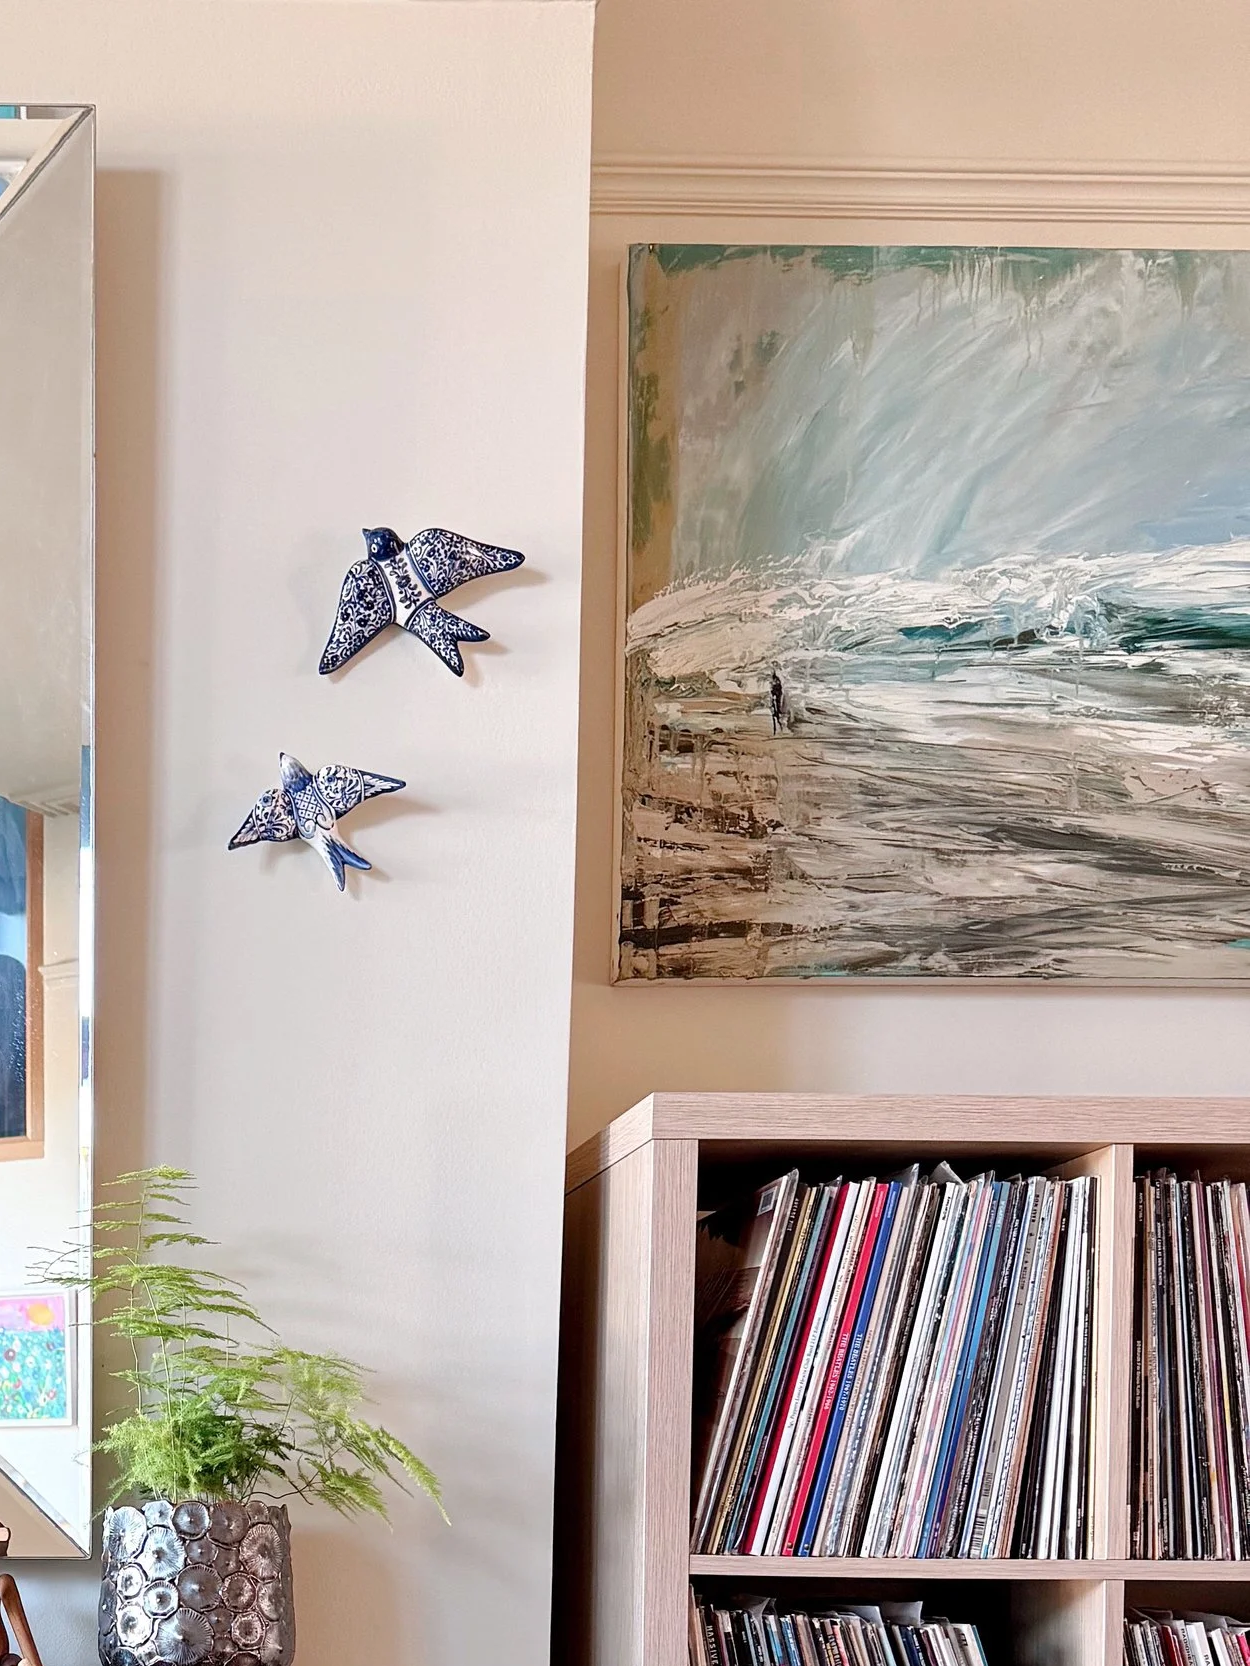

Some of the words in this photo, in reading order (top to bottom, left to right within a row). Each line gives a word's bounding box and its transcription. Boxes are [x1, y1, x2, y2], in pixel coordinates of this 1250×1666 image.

[839, 1332, 851, 1348] THE
[853, 1333, 864, 1348] THE
[830, 1348, 846, 1378] BEATLES
[845, 1350, 860, 1379] BEATLES
[837, 1380, 852, 1411] 1967-1970
[706, 1624, 718, 1664] MASSIVE
